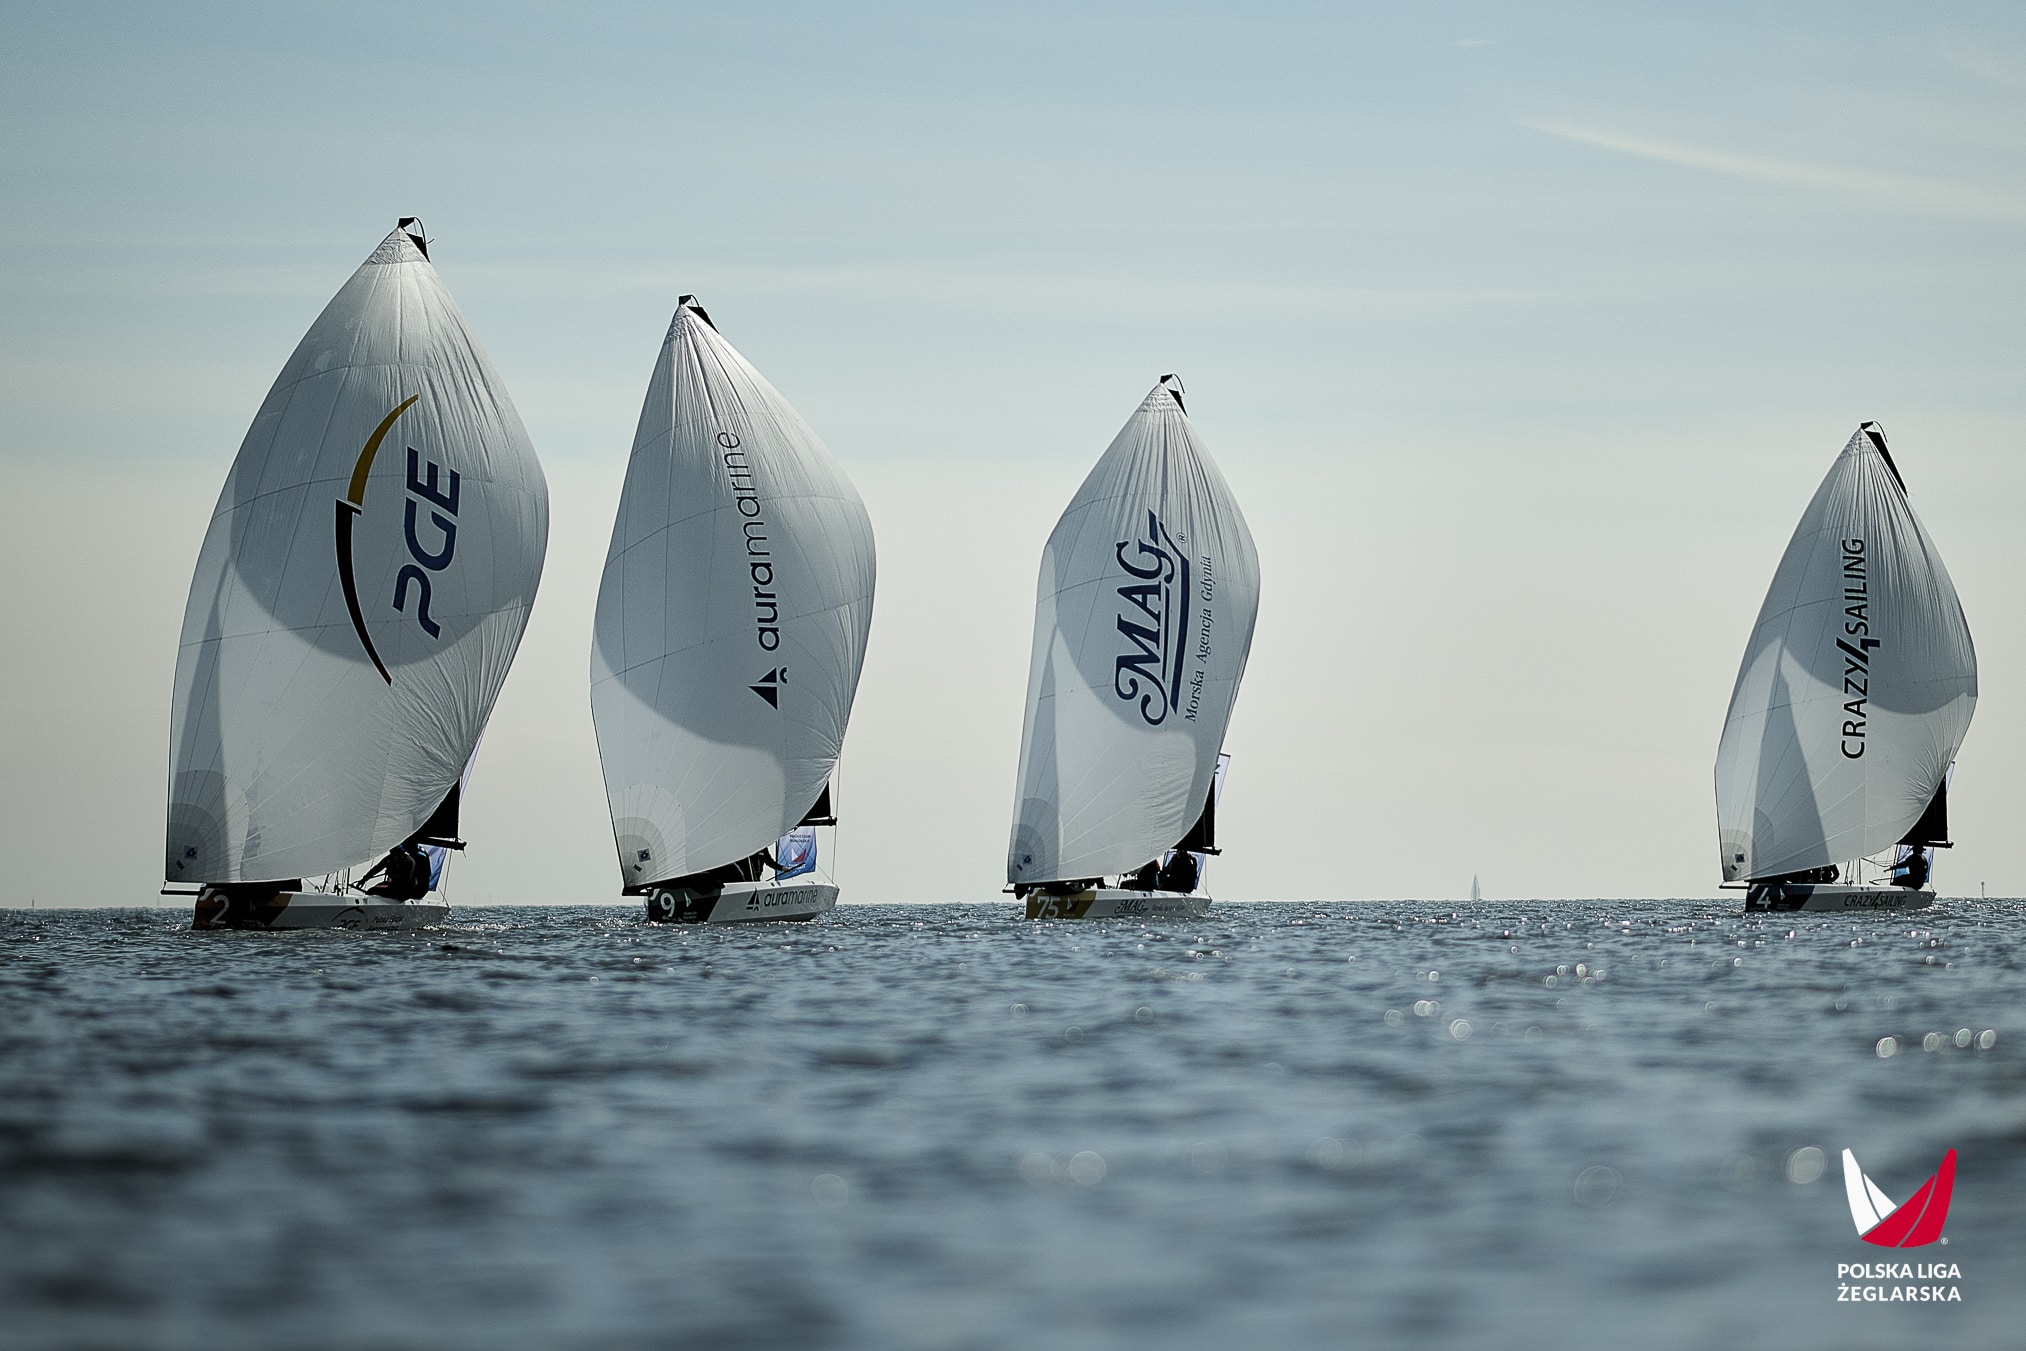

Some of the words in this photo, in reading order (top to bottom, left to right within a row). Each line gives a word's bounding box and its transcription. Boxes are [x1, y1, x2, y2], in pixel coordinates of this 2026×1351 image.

[392, 446, 460, 640] PGE
[717, 431, 780, 652] auramarine
[1200, 556, 1216, 602] Gdynia
[1115, 508, 1175, 726] MAG
[1195, 608, 1214, 664] Agencja
[1185, 670, 1205, 723] Morska
[210, 894, 230, 924] 2
[660, 892, 676, 918] 9
[763, 889, 819, 907] auramarine
[1037, 896, 1060, 919] 75
[1114, 899, 1149, 915] MAG
[1756, 887, 1772, 909] 4
